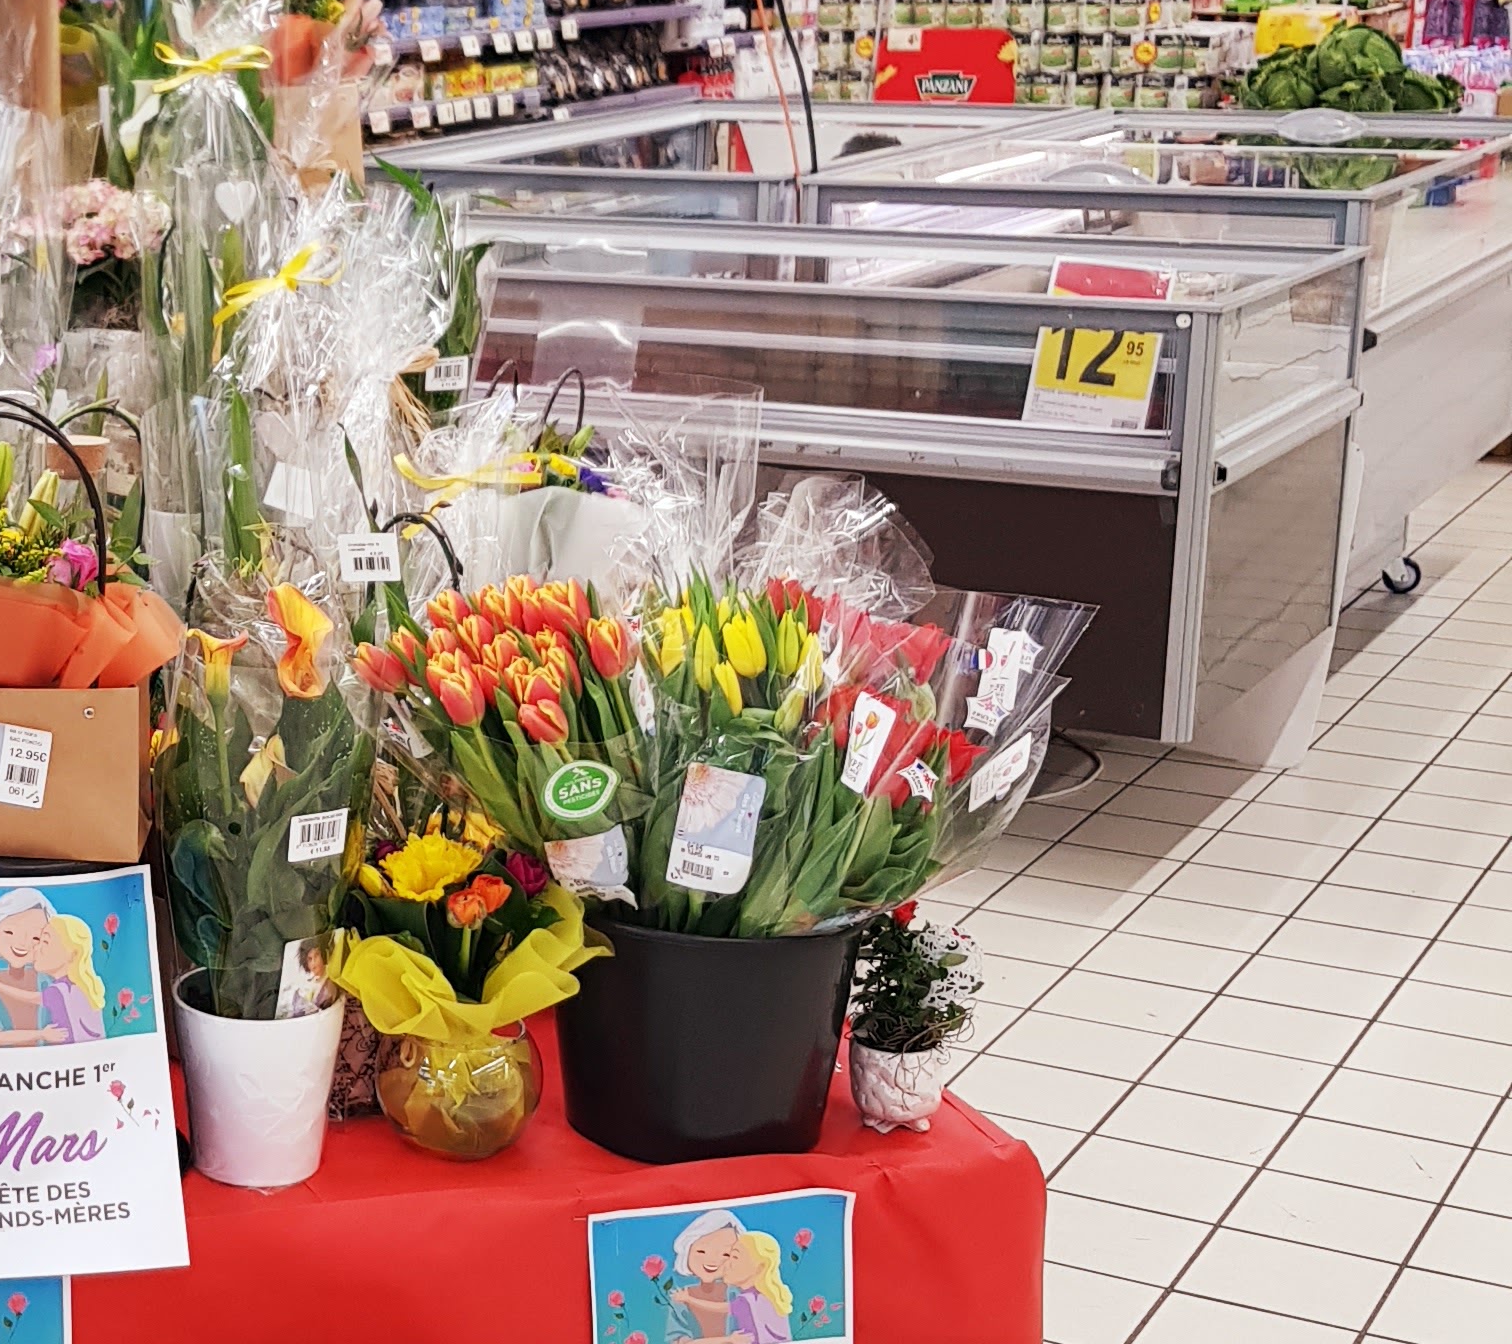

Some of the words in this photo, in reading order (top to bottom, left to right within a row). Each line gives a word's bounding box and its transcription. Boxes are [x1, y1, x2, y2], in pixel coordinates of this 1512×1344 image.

[921, 78, 969, 94] PANZANI
[1051, 327, 1124, 387] 12
[1126, 340, 1145, 357] 95
[558, 776, 602, 800] SANS
[93, 1061, 116, 1083] 1er
[47, 1181, 91, 1202] DES
